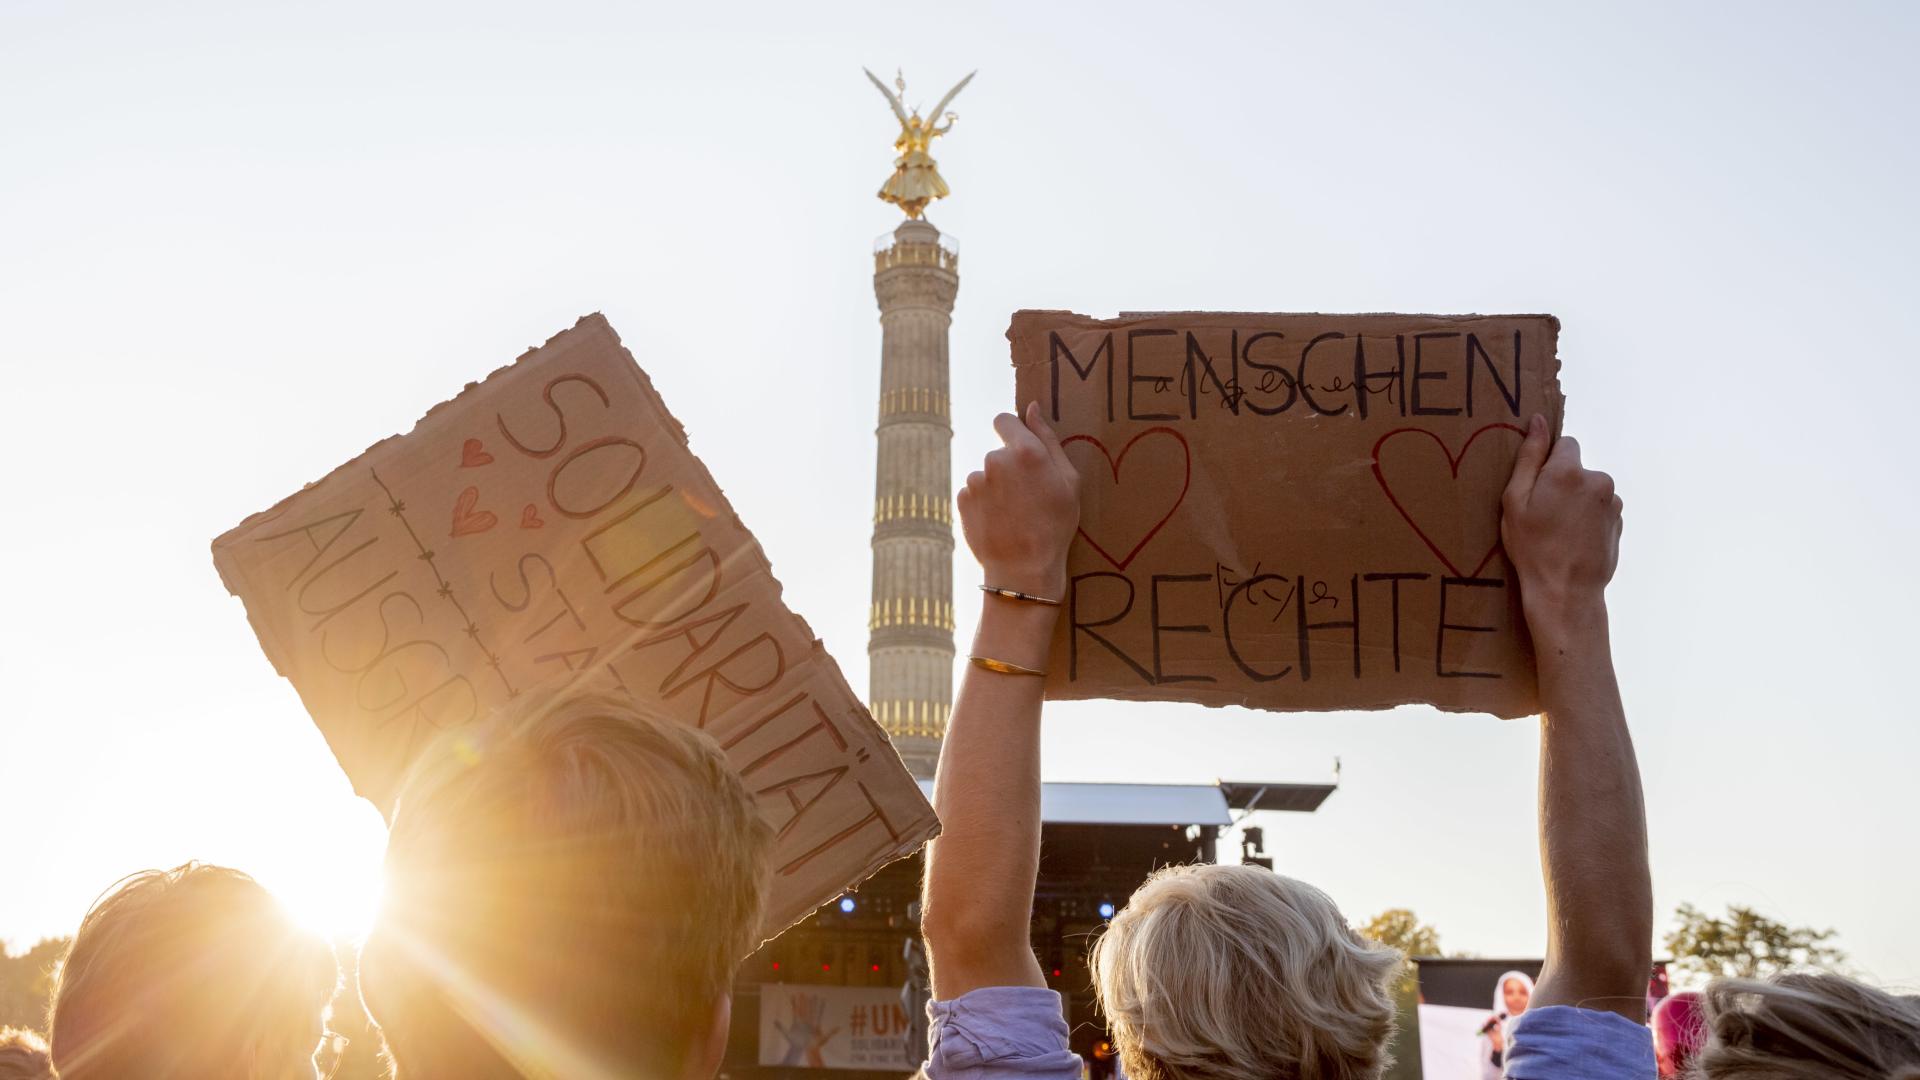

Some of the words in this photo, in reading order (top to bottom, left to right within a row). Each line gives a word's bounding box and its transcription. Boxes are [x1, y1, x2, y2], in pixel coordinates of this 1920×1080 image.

[1049, 328, 1521, 421] MENSCHEN
[497, 372, 901, 877] SOLIDARITÄT
[1069, 571, 1506, 684] RECHTE
